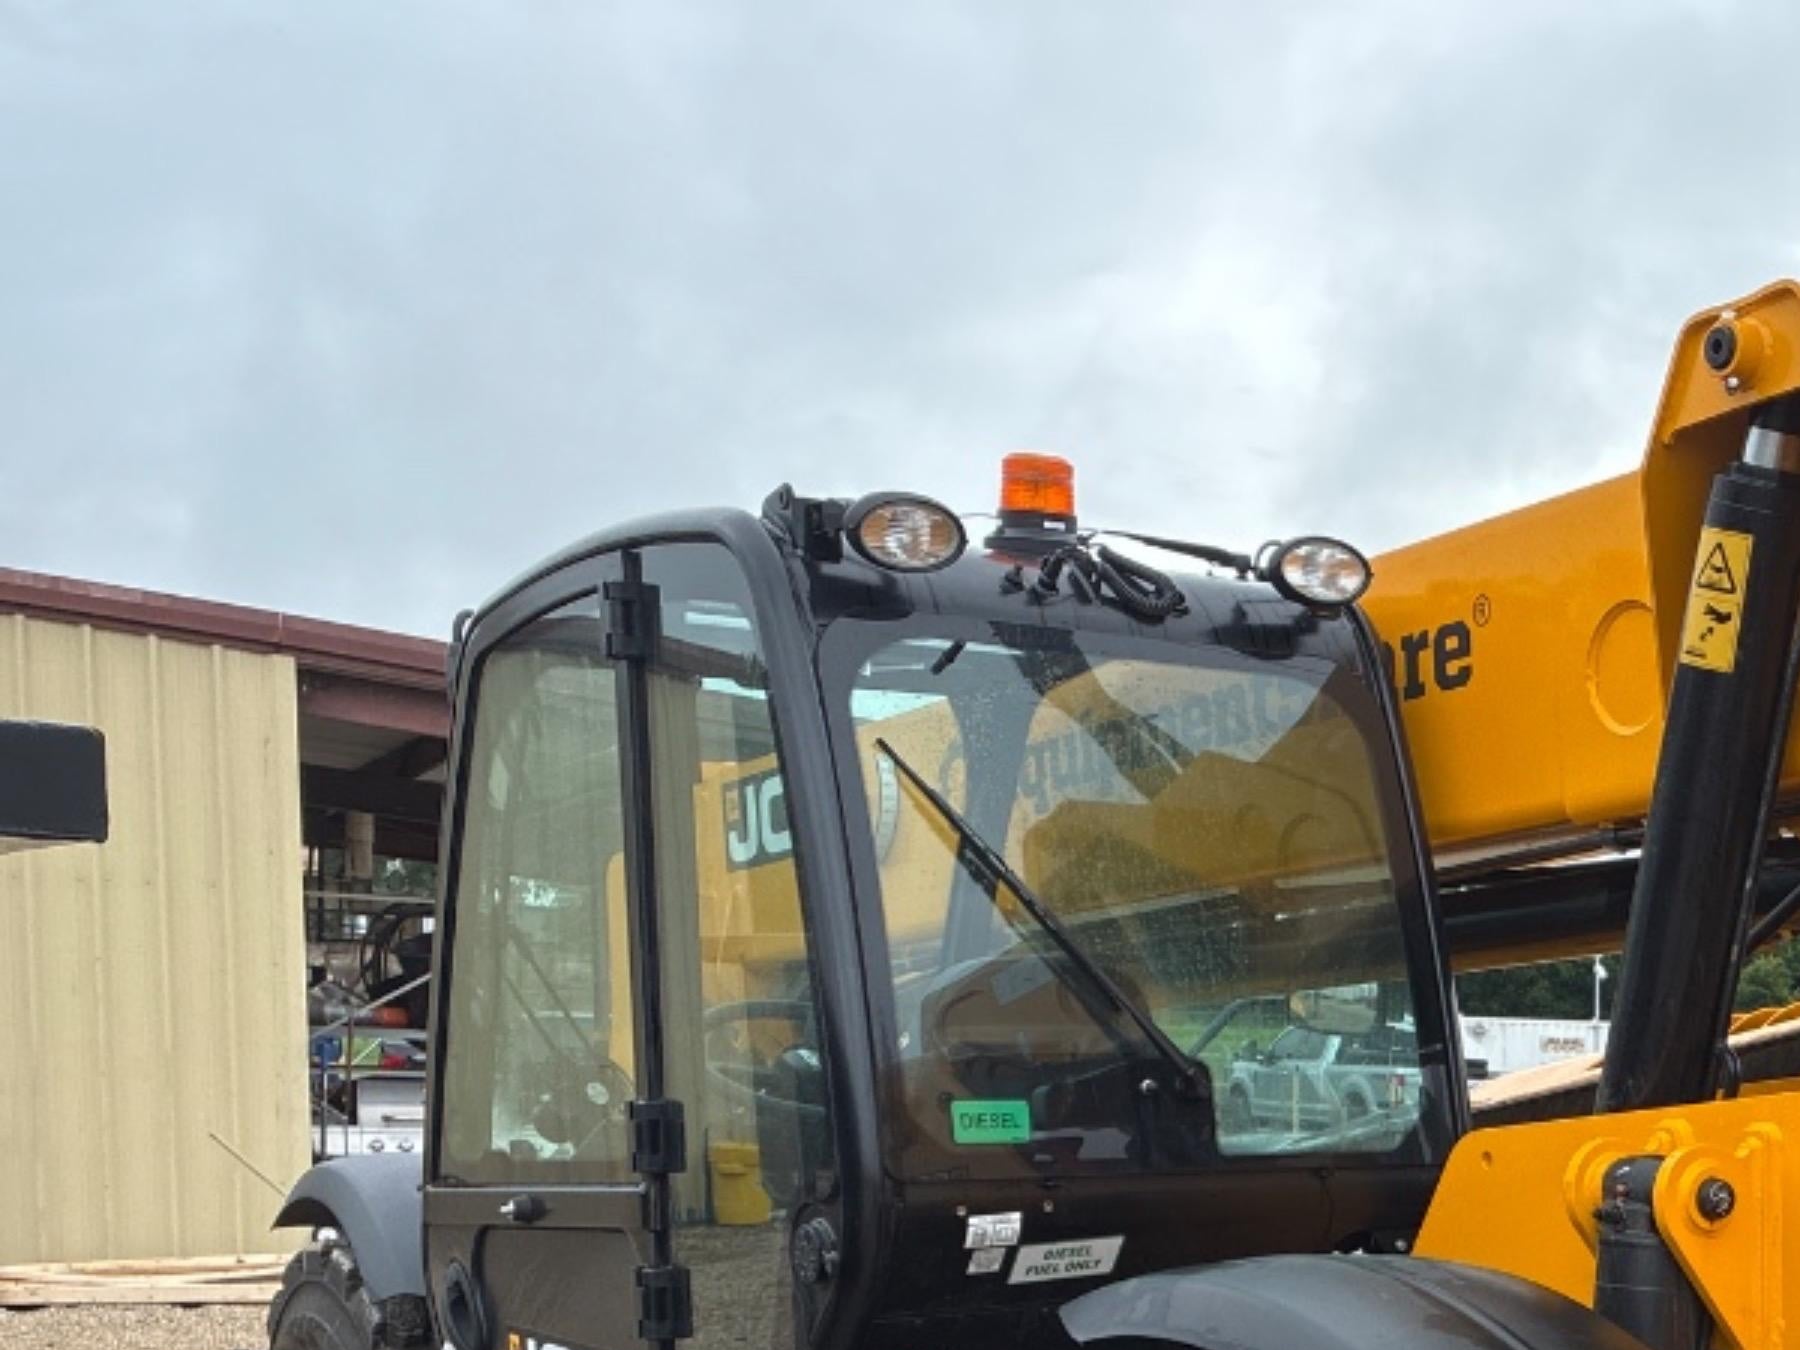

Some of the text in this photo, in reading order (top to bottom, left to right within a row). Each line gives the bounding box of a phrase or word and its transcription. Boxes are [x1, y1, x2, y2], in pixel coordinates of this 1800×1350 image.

[960, 1113, 1021, 1130] DIESEL
[1043, 1246, 1093, 1260] DIESEL
[1064, 1259, 1102, 1272] ONLY
